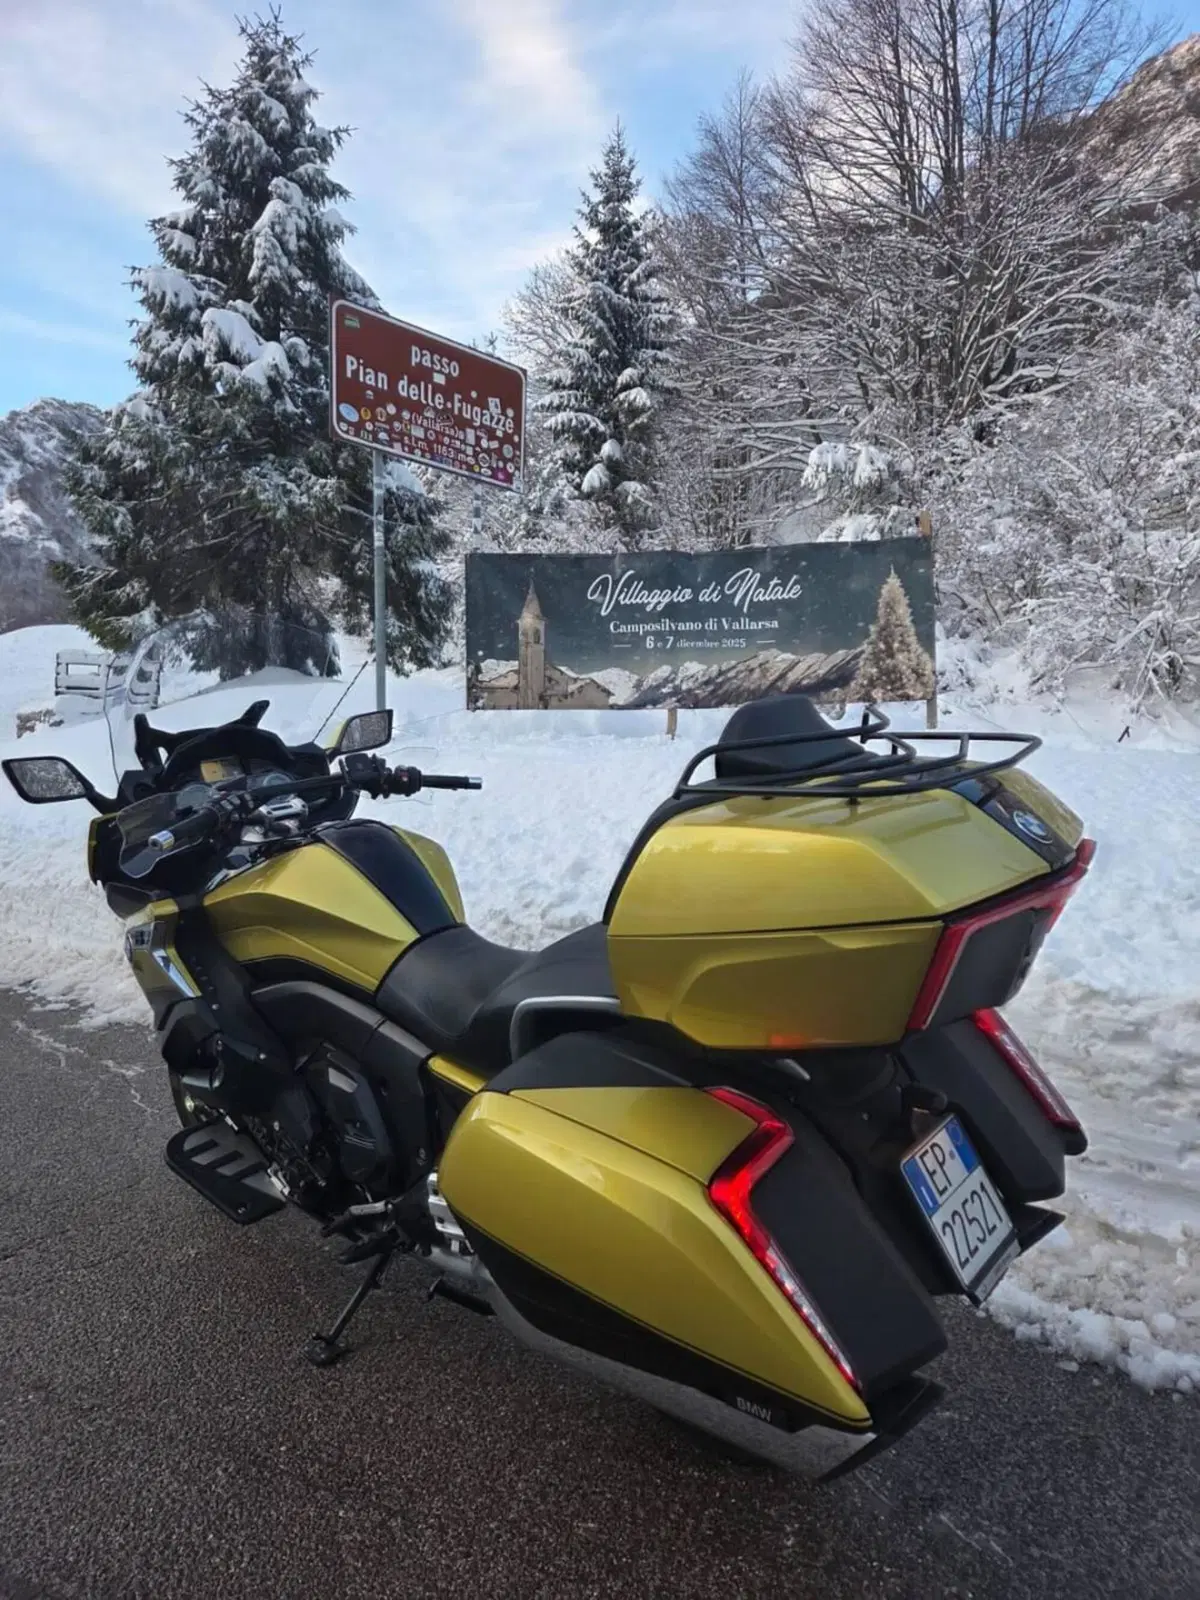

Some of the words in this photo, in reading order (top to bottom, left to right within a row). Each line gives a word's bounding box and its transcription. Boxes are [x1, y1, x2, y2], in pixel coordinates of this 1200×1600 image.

[411, 345, 460, 378] passo
[345, 354, 388, 391] Pian
[398, 375, 444, 410] delle
[453, 392, 514, 433] Fugazze
[433, 443, 454, 459] 1163
[587, 569, 693, 616] Villaggio
[699, 581, 722, 603] di
[724, 567, 802, 613] Natale
[610, 618, 702, 635] Camposilvano
[705, 618, 718, 631] di
[721, 617, 779, 631] Vallarsa
[646, 636, 655, 649] 6
[665, 636, 674, 649] 7
[676, 639, 719, 649] dicembre
[721, 638, 746, 649] 2025
[919, 1142, 952, 1197] EP
[941, 1181, 1004, 1269] 22521
